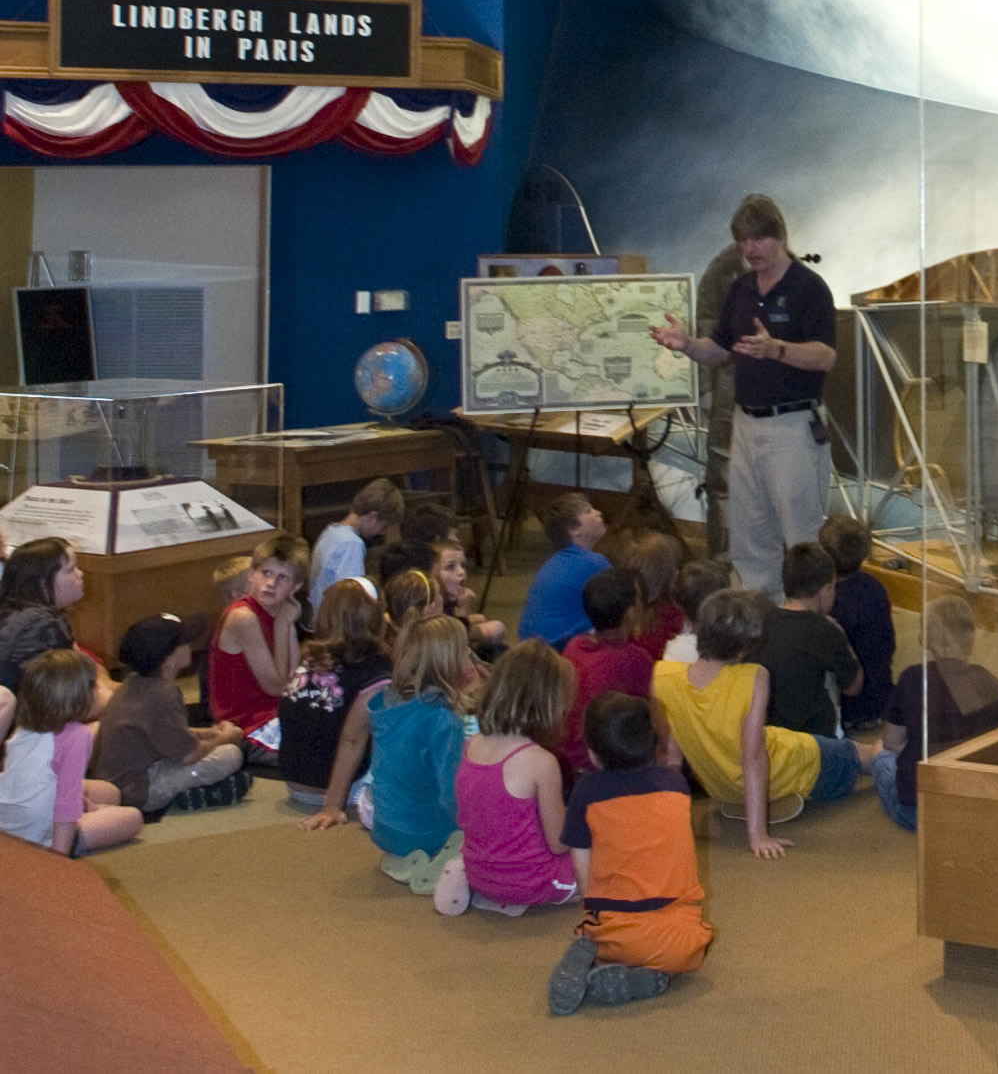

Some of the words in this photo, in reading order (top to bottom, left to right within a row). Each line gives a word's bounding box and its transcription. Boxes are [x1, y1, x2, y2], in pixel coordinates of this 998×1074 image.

[111, 3, 264, 33] LINDBERGH
[288, 11, 373, 37] LANDS
[183, 35, 212, 59] IN
[237, 38, 316, 63] PARIS
